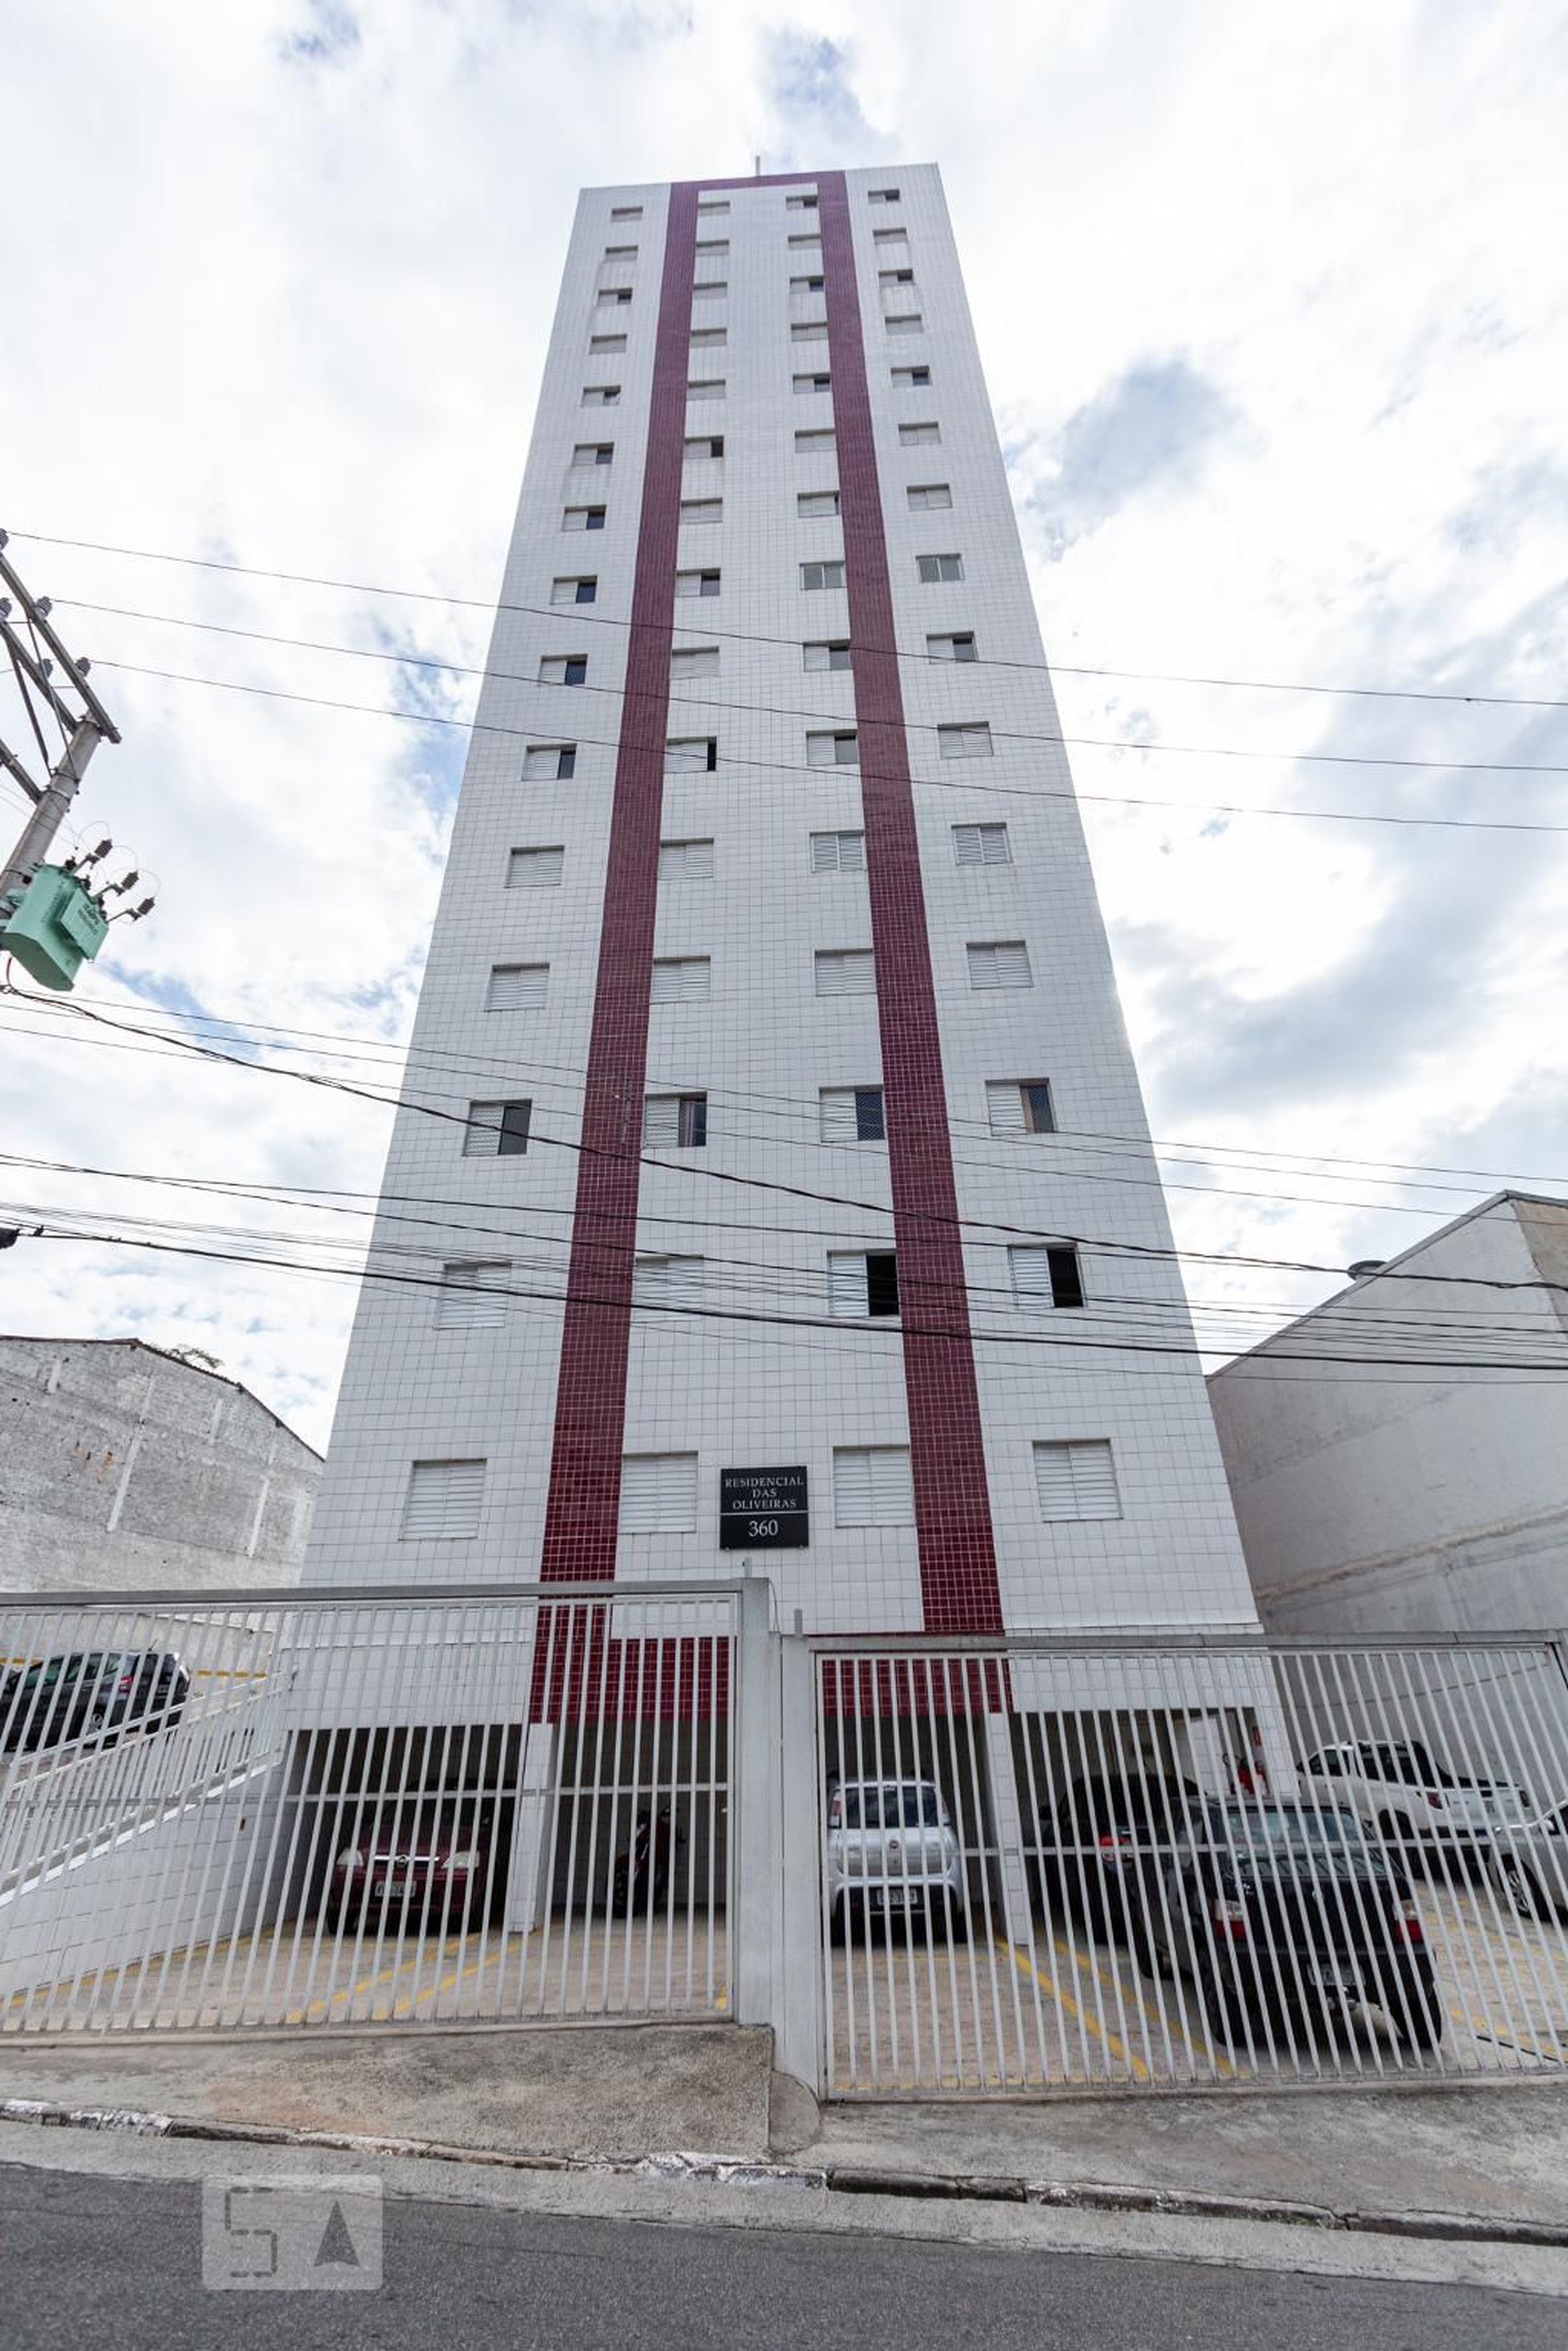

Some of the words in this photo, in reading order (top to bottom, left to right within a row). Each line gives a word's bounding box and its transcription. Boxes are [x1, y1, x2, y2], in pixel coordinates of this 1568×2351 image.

[725, 1476, 804, 1488] RESIDENCIAL
[753, 1488, 777, 1498] DAS
[733, 1499, 796, 1510] OLIVEIRAS
[748, 1519, 778, 1537] 360
